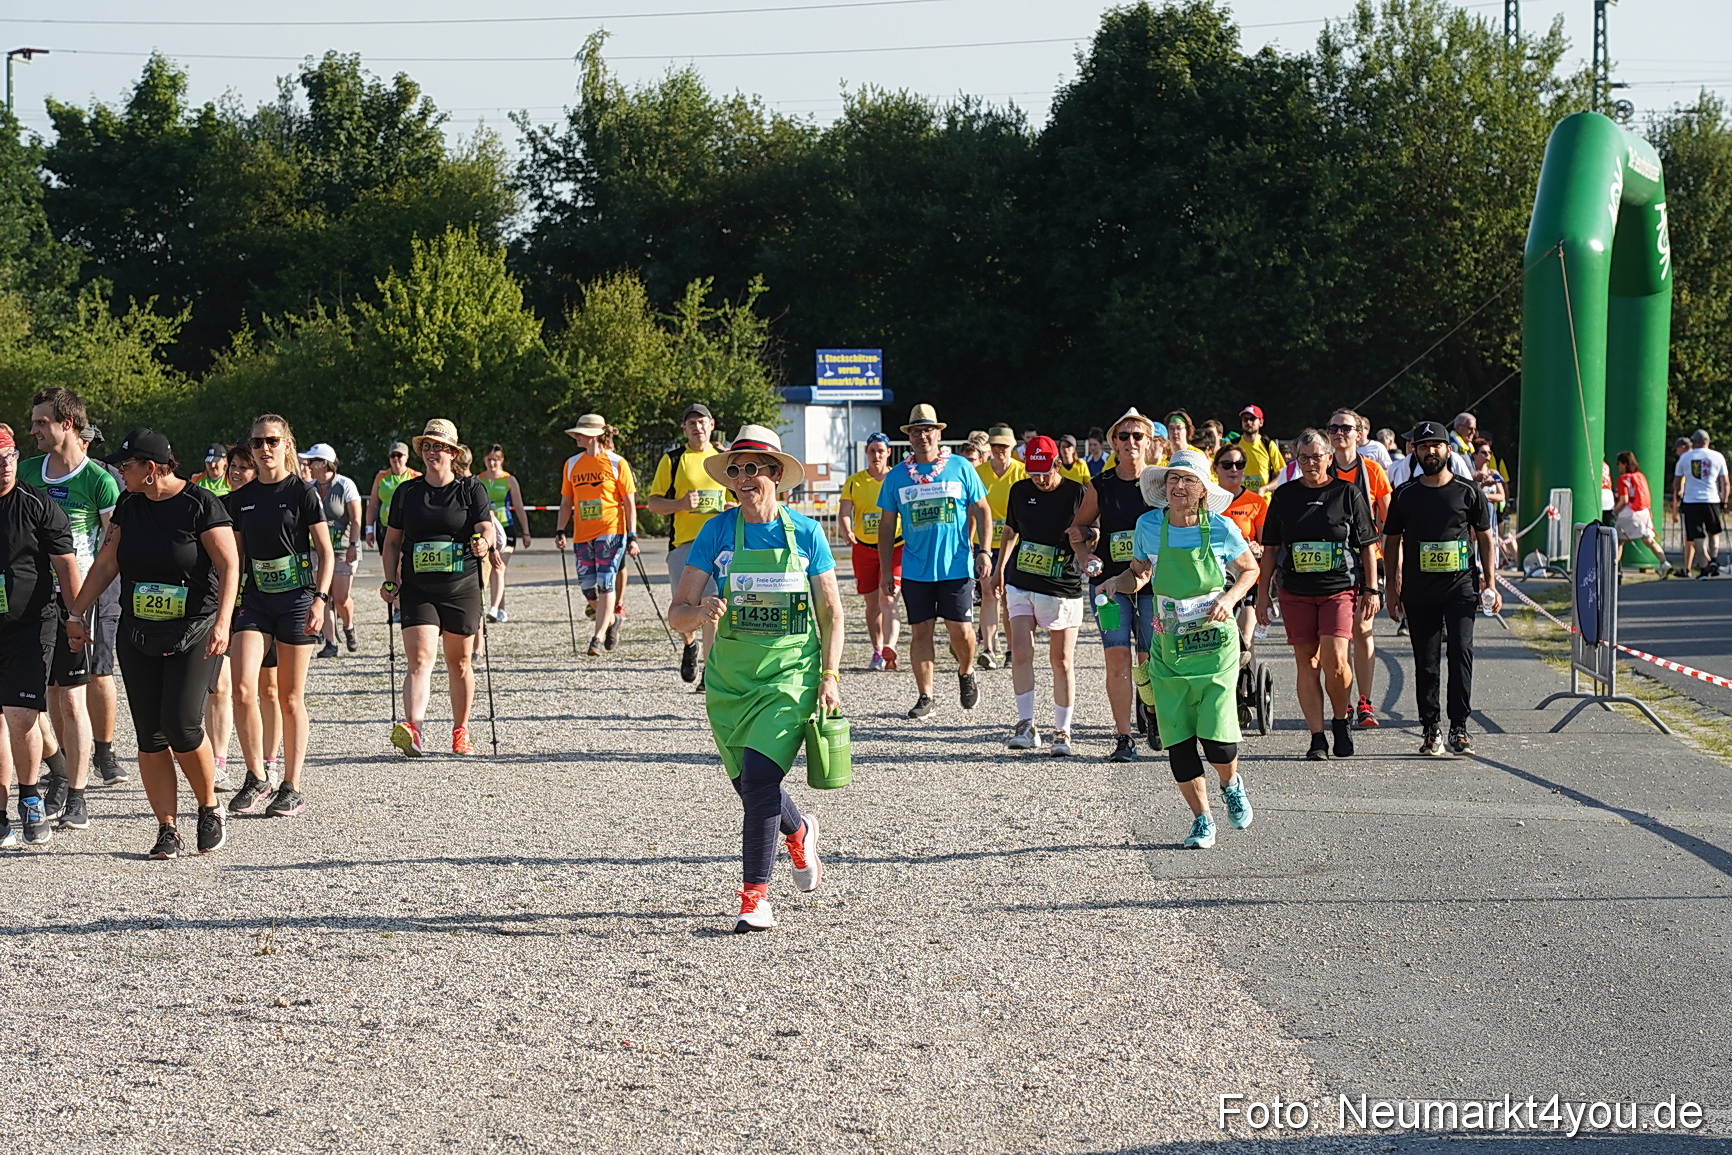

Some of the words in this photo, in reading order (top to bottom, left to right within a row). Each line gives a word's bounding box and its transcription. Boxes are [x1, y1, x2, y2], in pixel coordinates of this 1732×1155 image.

[577, 472, 611, 482] WINGS
[916, 507, 940, 518] 1440
[421, 552, 441, 562] 261
[1024, 552, 1043, 565] 272
[1301, 552, 1321, 562] 276
[1429, 552, 1450, 562] 267
[263, 570, 287, 582] 295
[146, 595, 171, 609] 281
[739, 607, 780, 621] 1438
[1184, 628, 1218, 645] 1437
